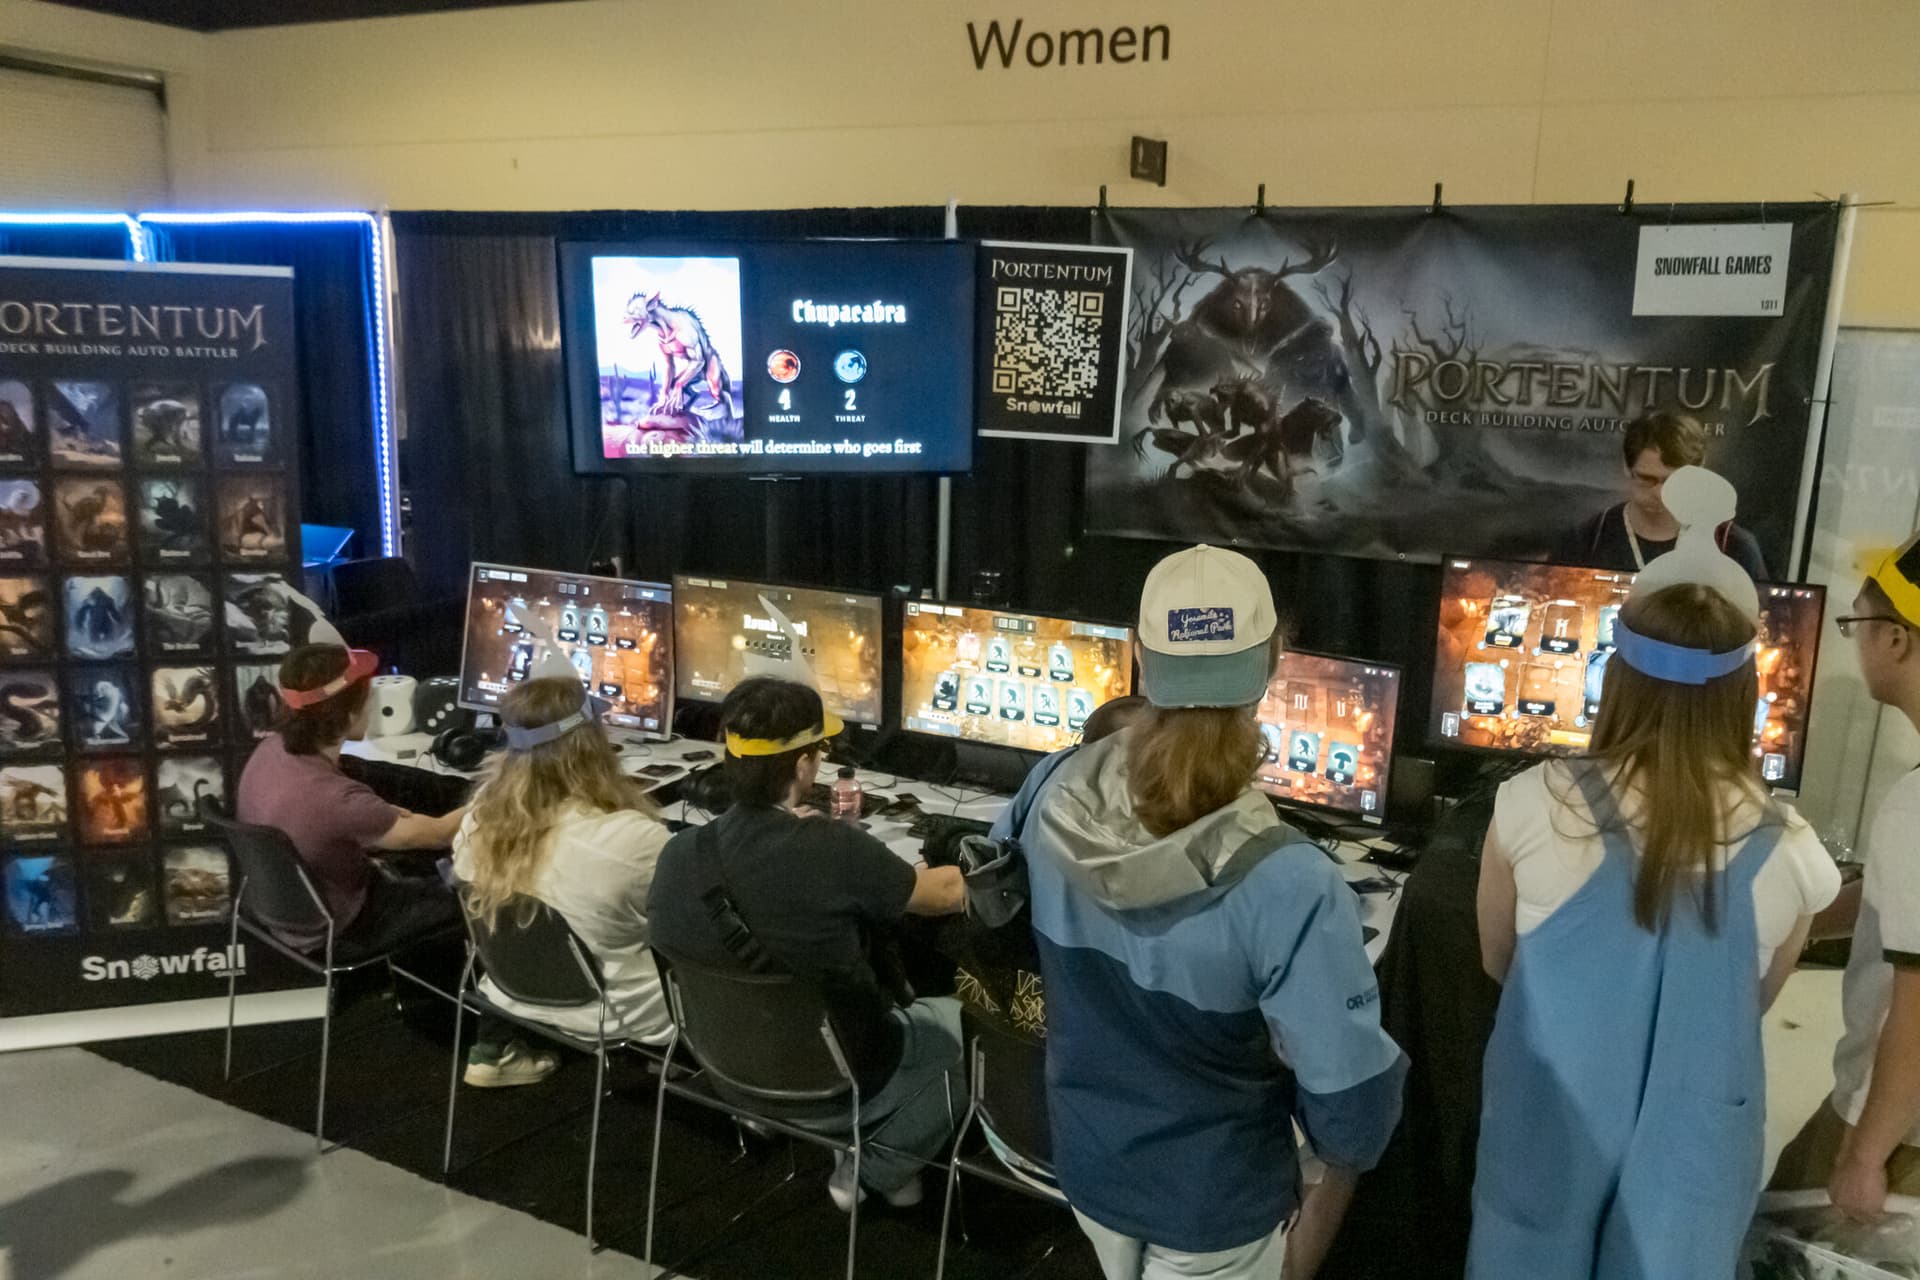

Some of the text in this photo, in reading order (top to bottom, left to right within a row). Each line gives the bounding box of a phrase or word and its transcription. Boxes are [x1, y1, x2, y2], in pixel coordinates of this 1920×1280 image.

[966, 18, 1171, 70] Women
[991, 259, 1113, 287] PORTENTUM
[1654, 255, 1772, 275] SNOWFALL GAMES
[792, 299, 907, 328] Chupacabra
[1761, 300, 1778, 310] 1311
[0, 302, 268, 350] ORTENTUM
[0, 343, 238, 359] DECK BUILDING AUTO BATTLER
[778, 388, 792, 411] 4
[844, 388, 857, 411] 2
[1391, 350, 1777, 427] PORTENTUM
[768, 415, 801, 423] HEALTH
[835, 415, 866, 423] THREAT
[1426, 410, 1473, 425] DECK
[1481, 413, 1572, 431] BUILDING
[625, 438, 922, 458] the higher threat will determine who goes first
